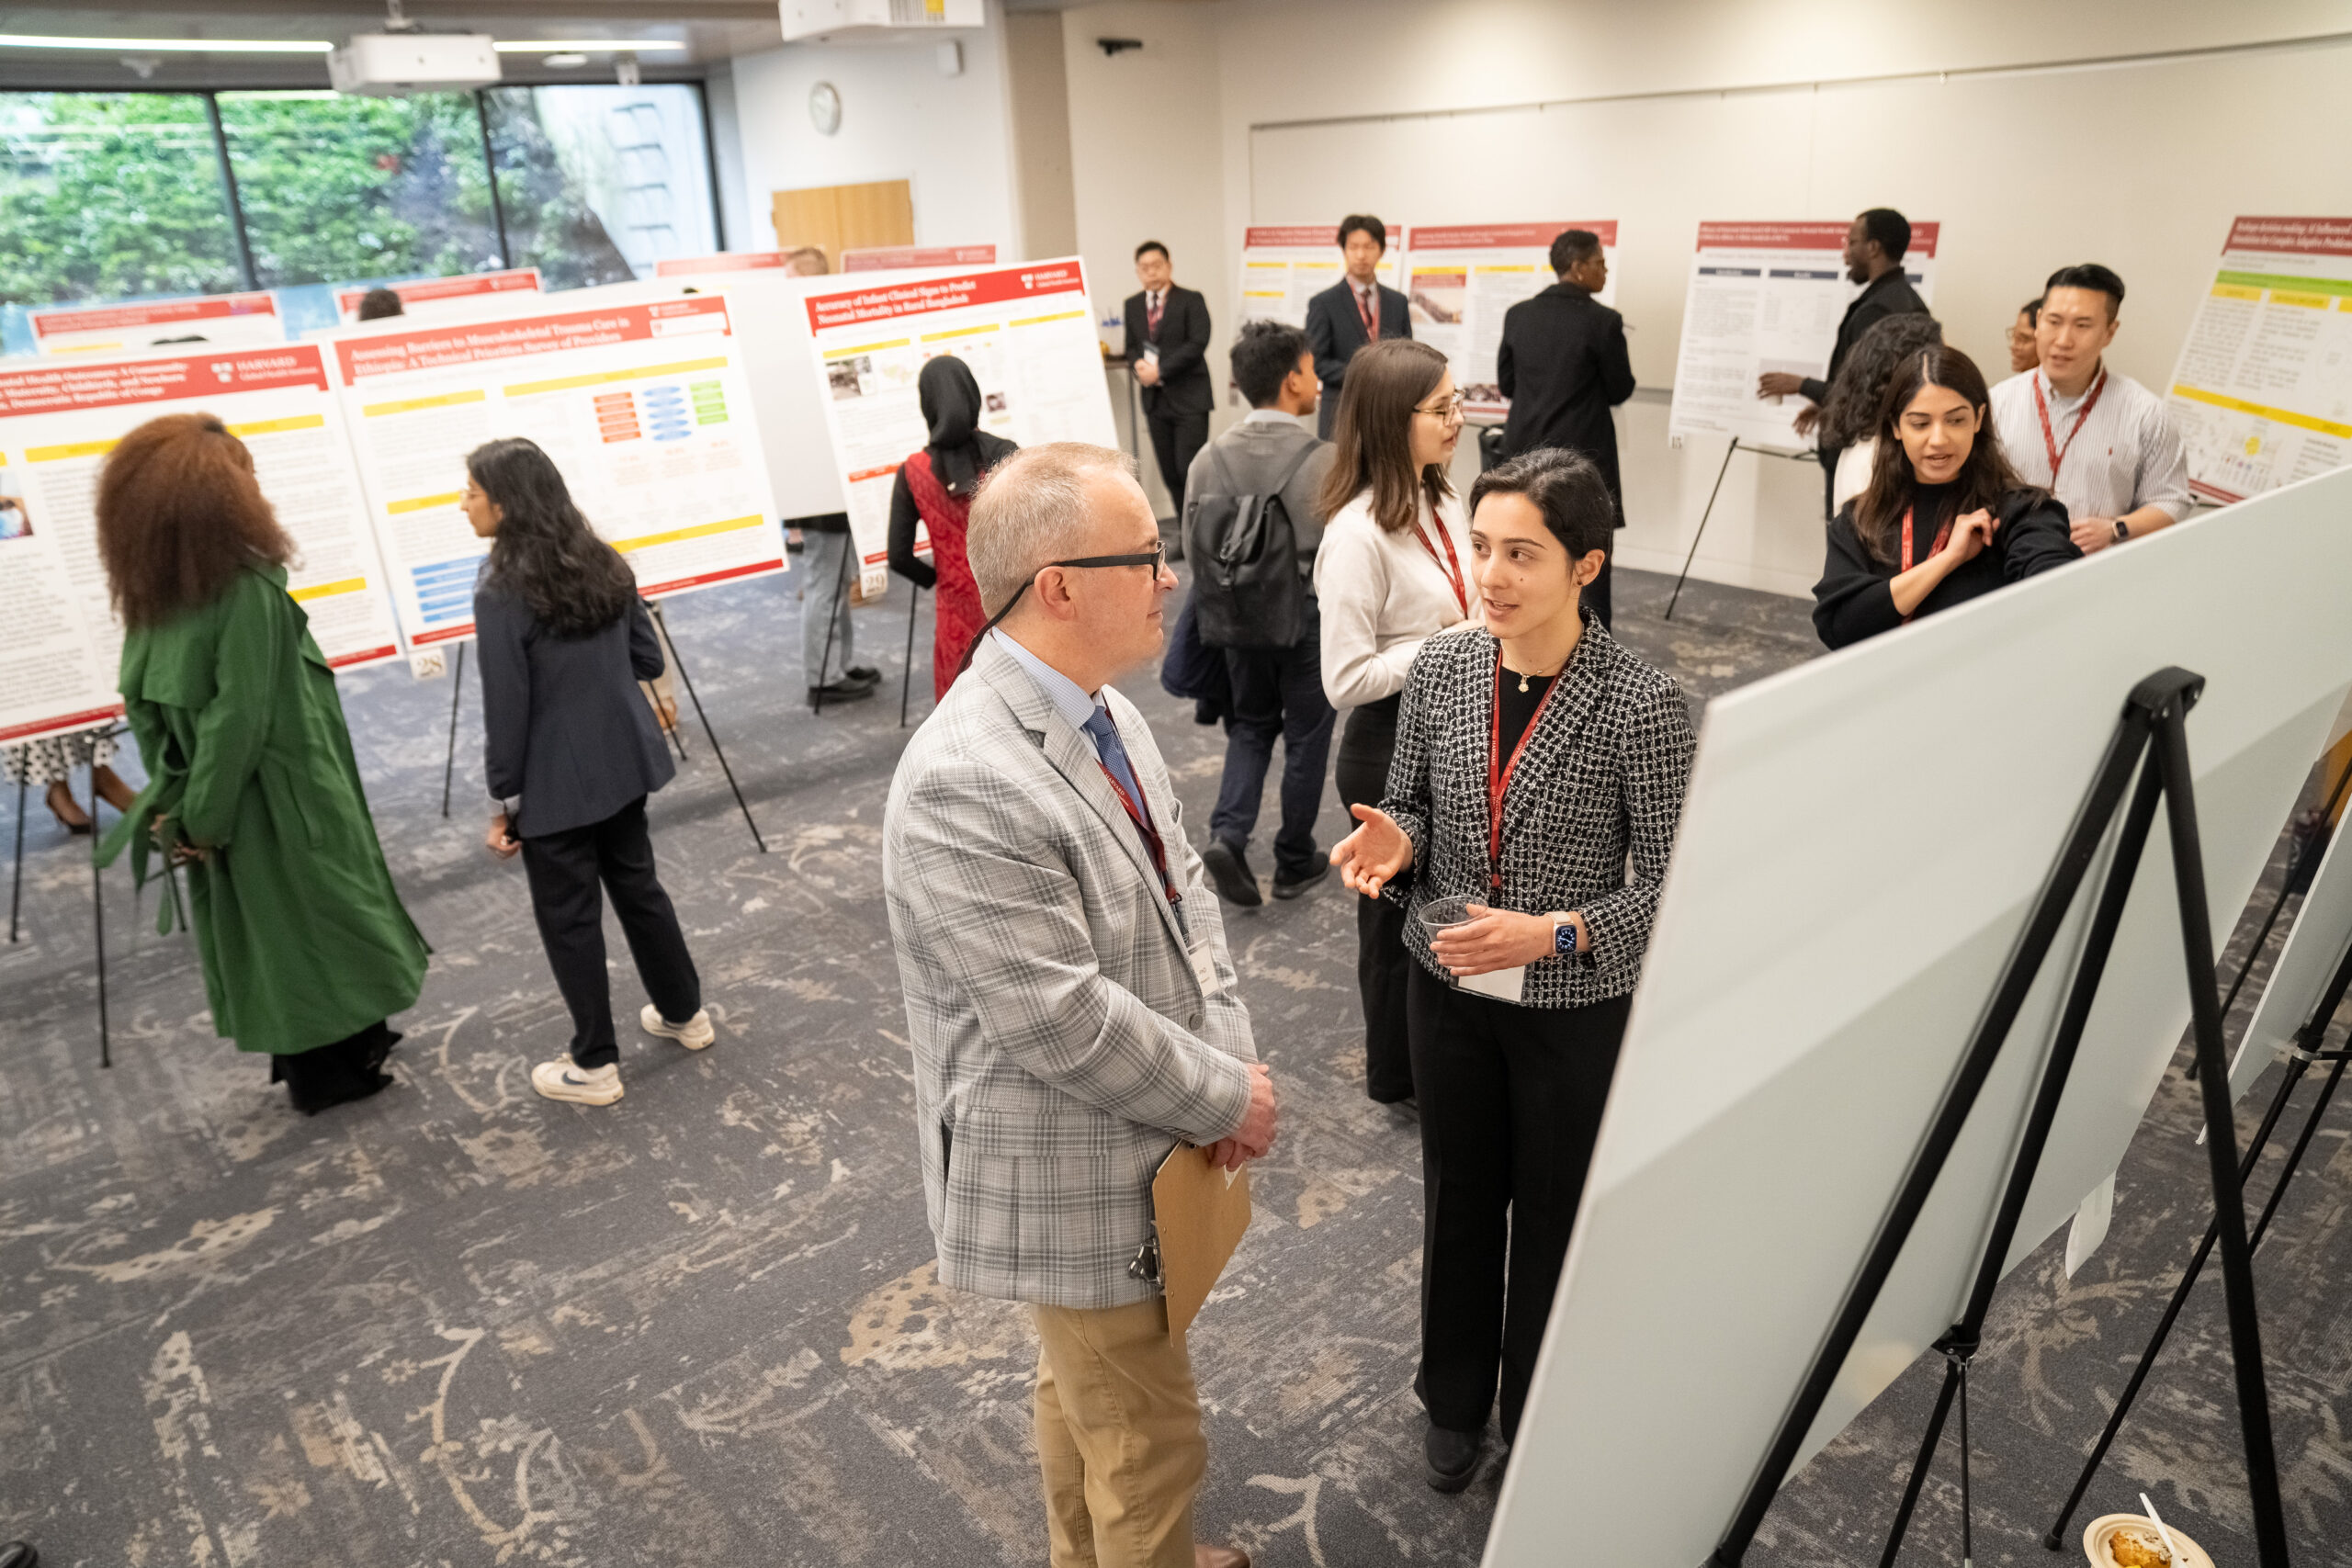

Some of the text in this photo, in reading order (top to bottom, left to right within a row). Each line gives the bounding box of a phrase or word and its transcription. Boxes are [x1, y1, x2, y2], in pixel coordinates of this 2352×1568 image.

[815, 299, 853, 312] Accuracy
[853, 294, 863, 306] of
[888, 288, 918, 301] Clinical
[940, 284, 949, 294] to
[948, 280, 978, 293] Predict
[817, 310, 855, 325] Neonatal
[855, 303, 893, 320] Mortality
[903, 299, 926, 312] Rural
[925, 293, 969, 310] Bangladesh
[351, 315, 630, 361] Assessing Barriers to Musculoskeletal Trauma Care in
[409, 355, 420, 369] A
[419, 347, 472, 367] Technical
[472, 344, 522, 360] Priorities
[522, 341, 559, 355] Survey
[560, 335, 571, 347] of
[572, 332, 623, 347] Providers
[236, 355, 298, 372] HARVARD
[26, 373, 62, 386] Health
[119, 377, 140, 389] and
[140, 373, 187, 385] Newborn
[10, 394, 73, 410] Democratic
[73, 389, 119, 404] Republic
[119, 387, 131, 399] of
[865, 574, 885, 589] 29
[416, 654, 444, 674] 28
[1536, 693, 1552, 716] HARVARD
[1508, 743, 1523, 767] HARVARD
[1104, 773, 1125, 796] HARVARD
